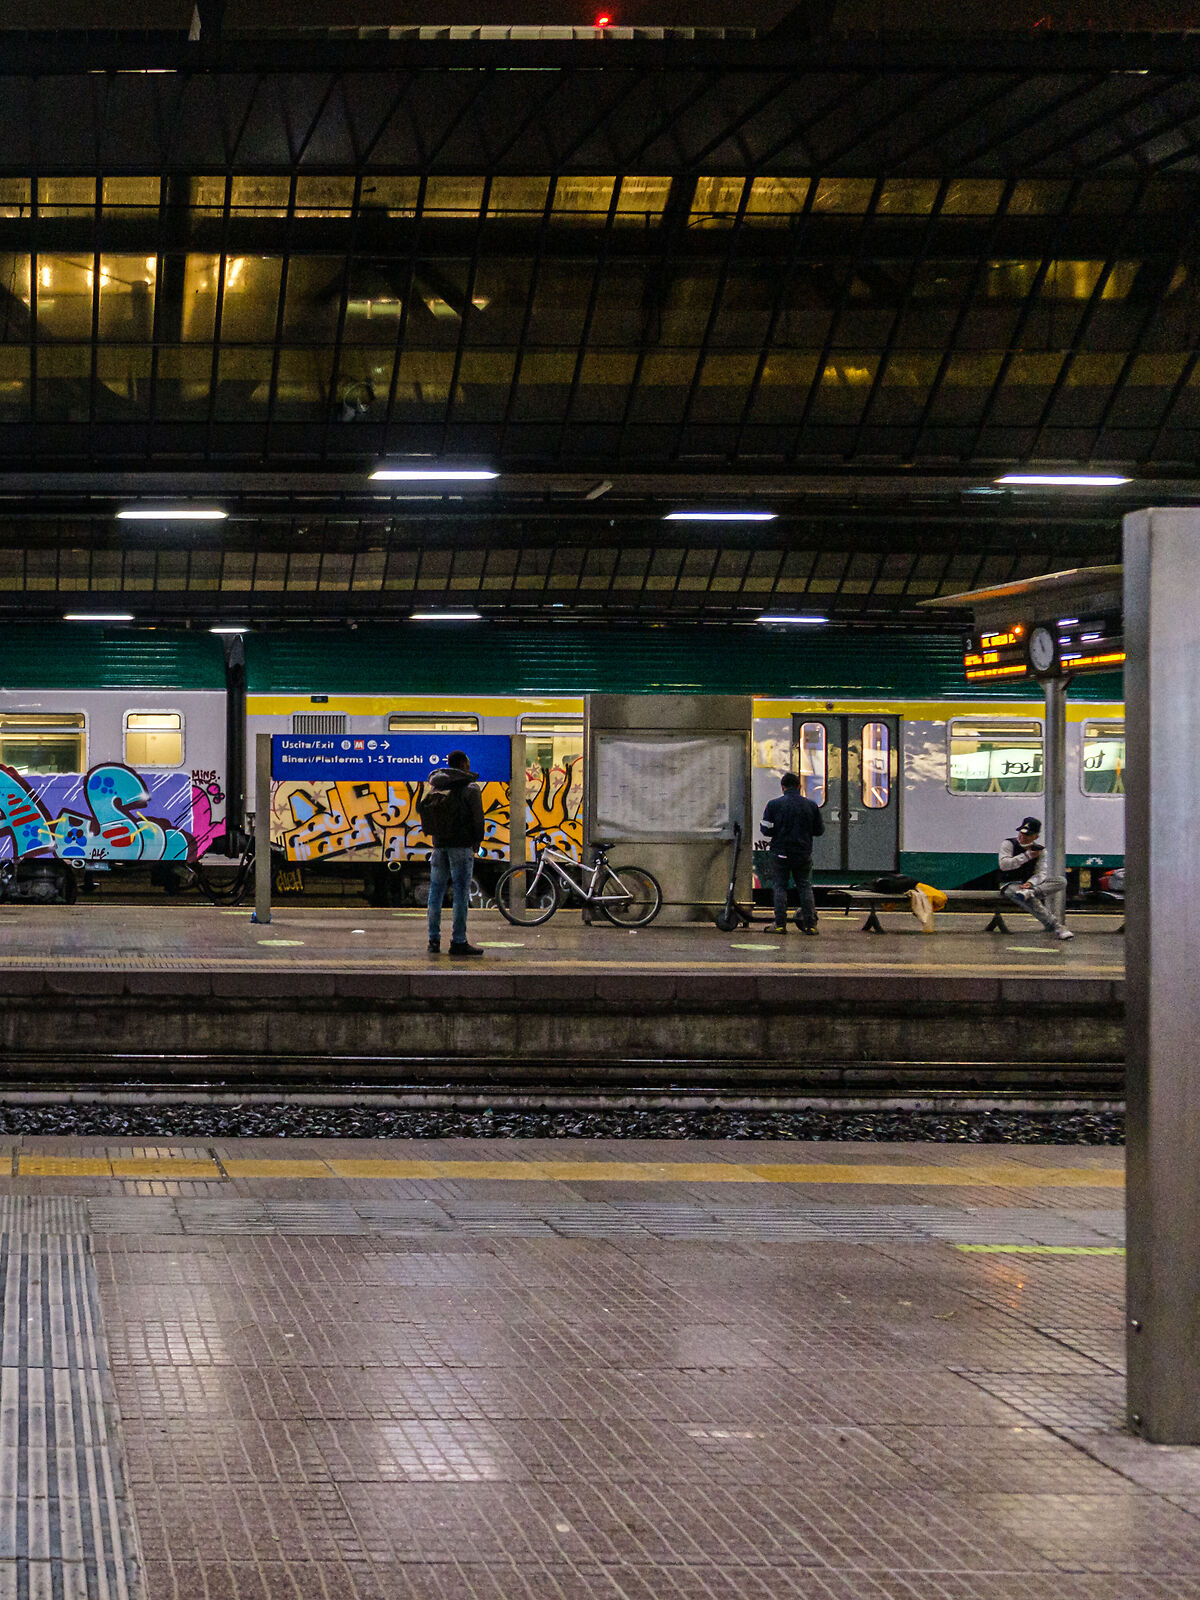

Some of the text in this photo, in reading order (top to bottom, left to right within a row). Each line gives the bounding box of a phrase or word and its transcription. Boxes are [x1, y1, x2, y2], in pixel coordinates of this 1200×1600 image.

[281, 740, 334, 749] Uscita/Exit
[281, 754, 424, 764] Binari/Platforms 1-5 Tronchi
